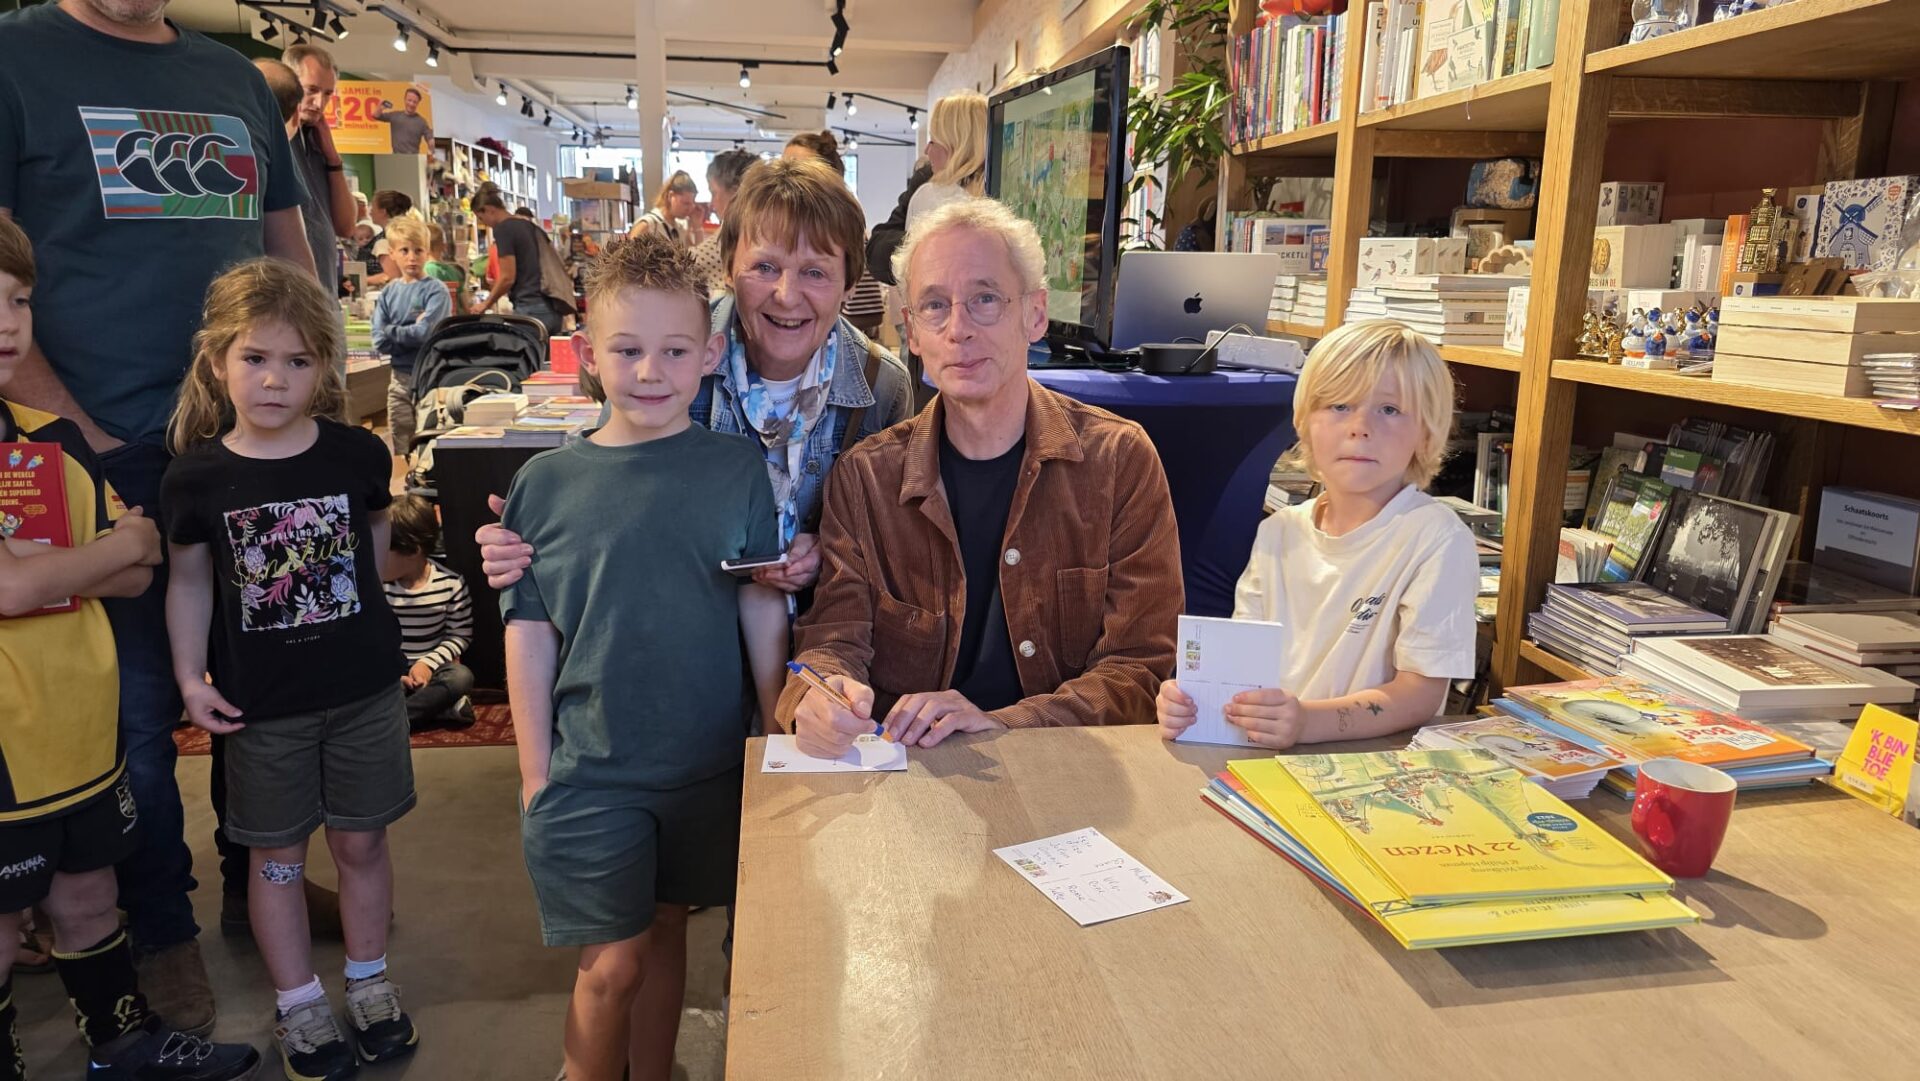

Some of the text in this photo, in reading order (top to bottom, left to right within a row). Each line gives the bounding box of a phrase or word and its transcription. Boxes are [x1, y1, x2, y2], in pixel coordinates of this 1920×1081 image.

[342, 96, 382, 122] 20
[344, 122, 379, 130] minuten
[9, 488, 41, 496] SUPERHELD
[1843, 504, 1889, 521] Schaatskoorts
[271, 528, 313, 543] WALKING
[231, 530, 360, 590] Sunshine
[1867, 745, 1897, 768] BLIE
[1884, 735, 1910, 757] BIN
[1861, 758, 1889, 781] TOE
[1384, 841, 1521, 857] 22 Wezen
[0, 854, 47, 876] AKUMA
